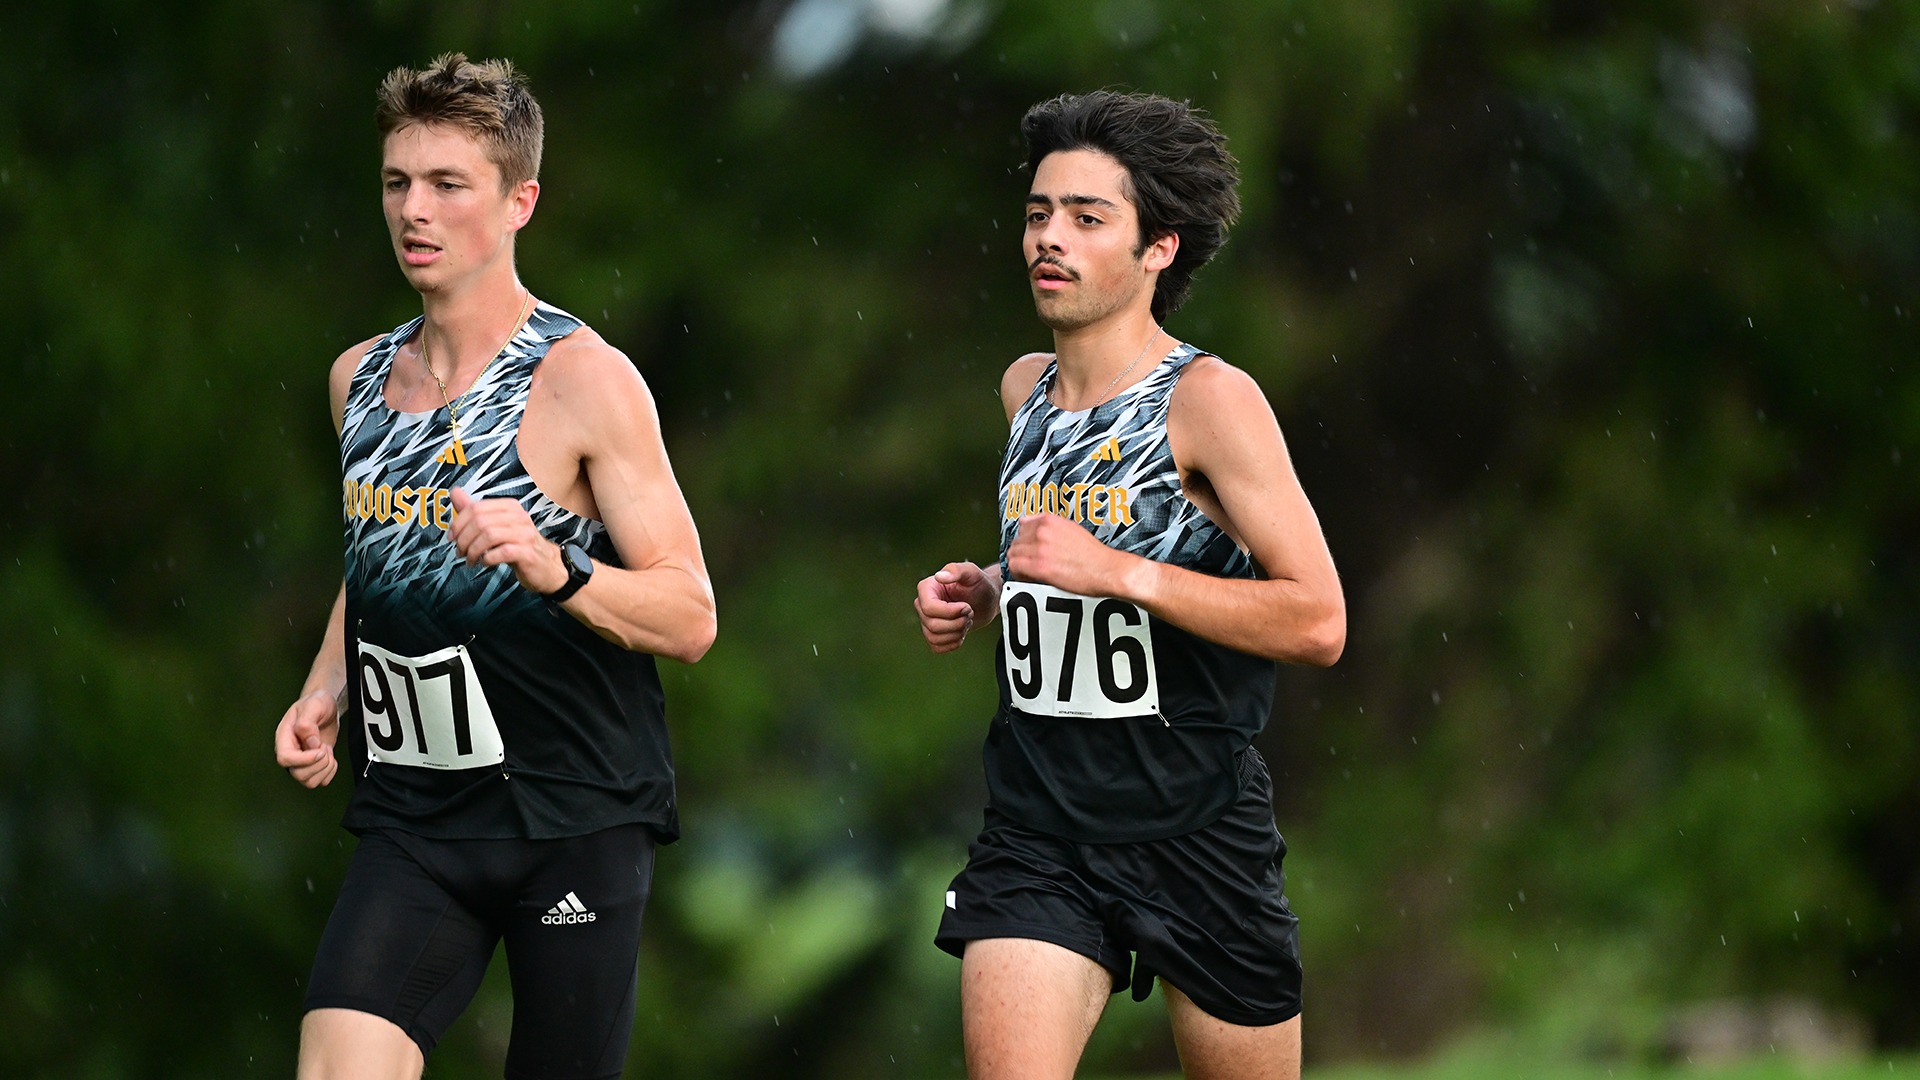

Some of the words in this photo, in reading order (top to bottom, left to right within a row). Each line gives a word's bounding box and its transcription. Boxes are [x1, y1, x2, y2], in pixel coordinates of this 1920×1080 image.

[343, 479, 460, 531] WOOSTE
[1005, 481, 1135, 527] WOOSTER
[1007, 591, 1149, 703] 976
[360, 651, 473, 756] 977
[541, 912, 596, 925] adidas
